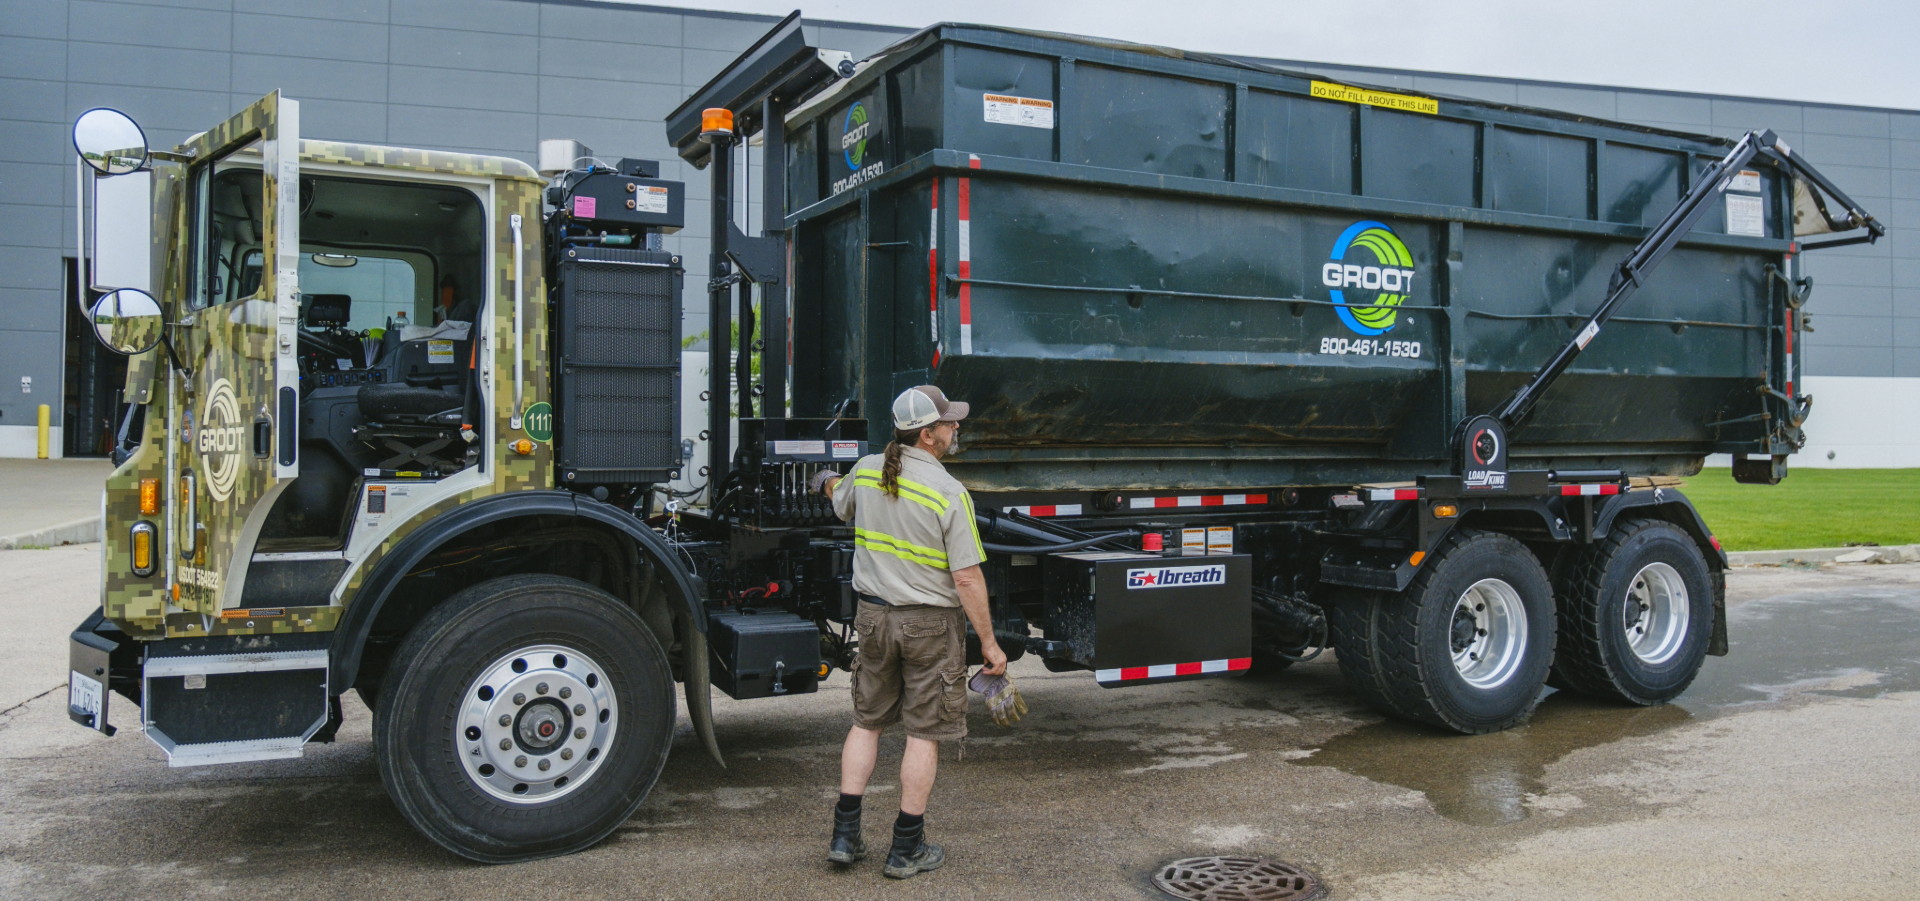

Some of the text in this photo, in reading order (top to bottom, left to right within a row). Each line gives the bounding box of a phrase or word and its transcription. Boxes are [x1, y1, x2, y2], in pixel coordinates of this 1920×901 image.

[990, 95, 1018, 104] WARNING
[1025, 100, 1052, 108] WARNING
[1313, 86, 1436, 112] DO NOT FILL ABOVE THIS LINE
[842, 121, 870, 149] GROOT
[832, 160, 884, 197] 800-461-1530
[1322, 262, 1415, 292] GROOT
[1320, 337, 1421, 358] 800-461-1530
[199, 426, 245, 452] GROOT
[1468, 470, 1486, 480] LOAD
[1488, 475, 1505, 485] KING
[178, 565, 219, 589] USDOT 564822
